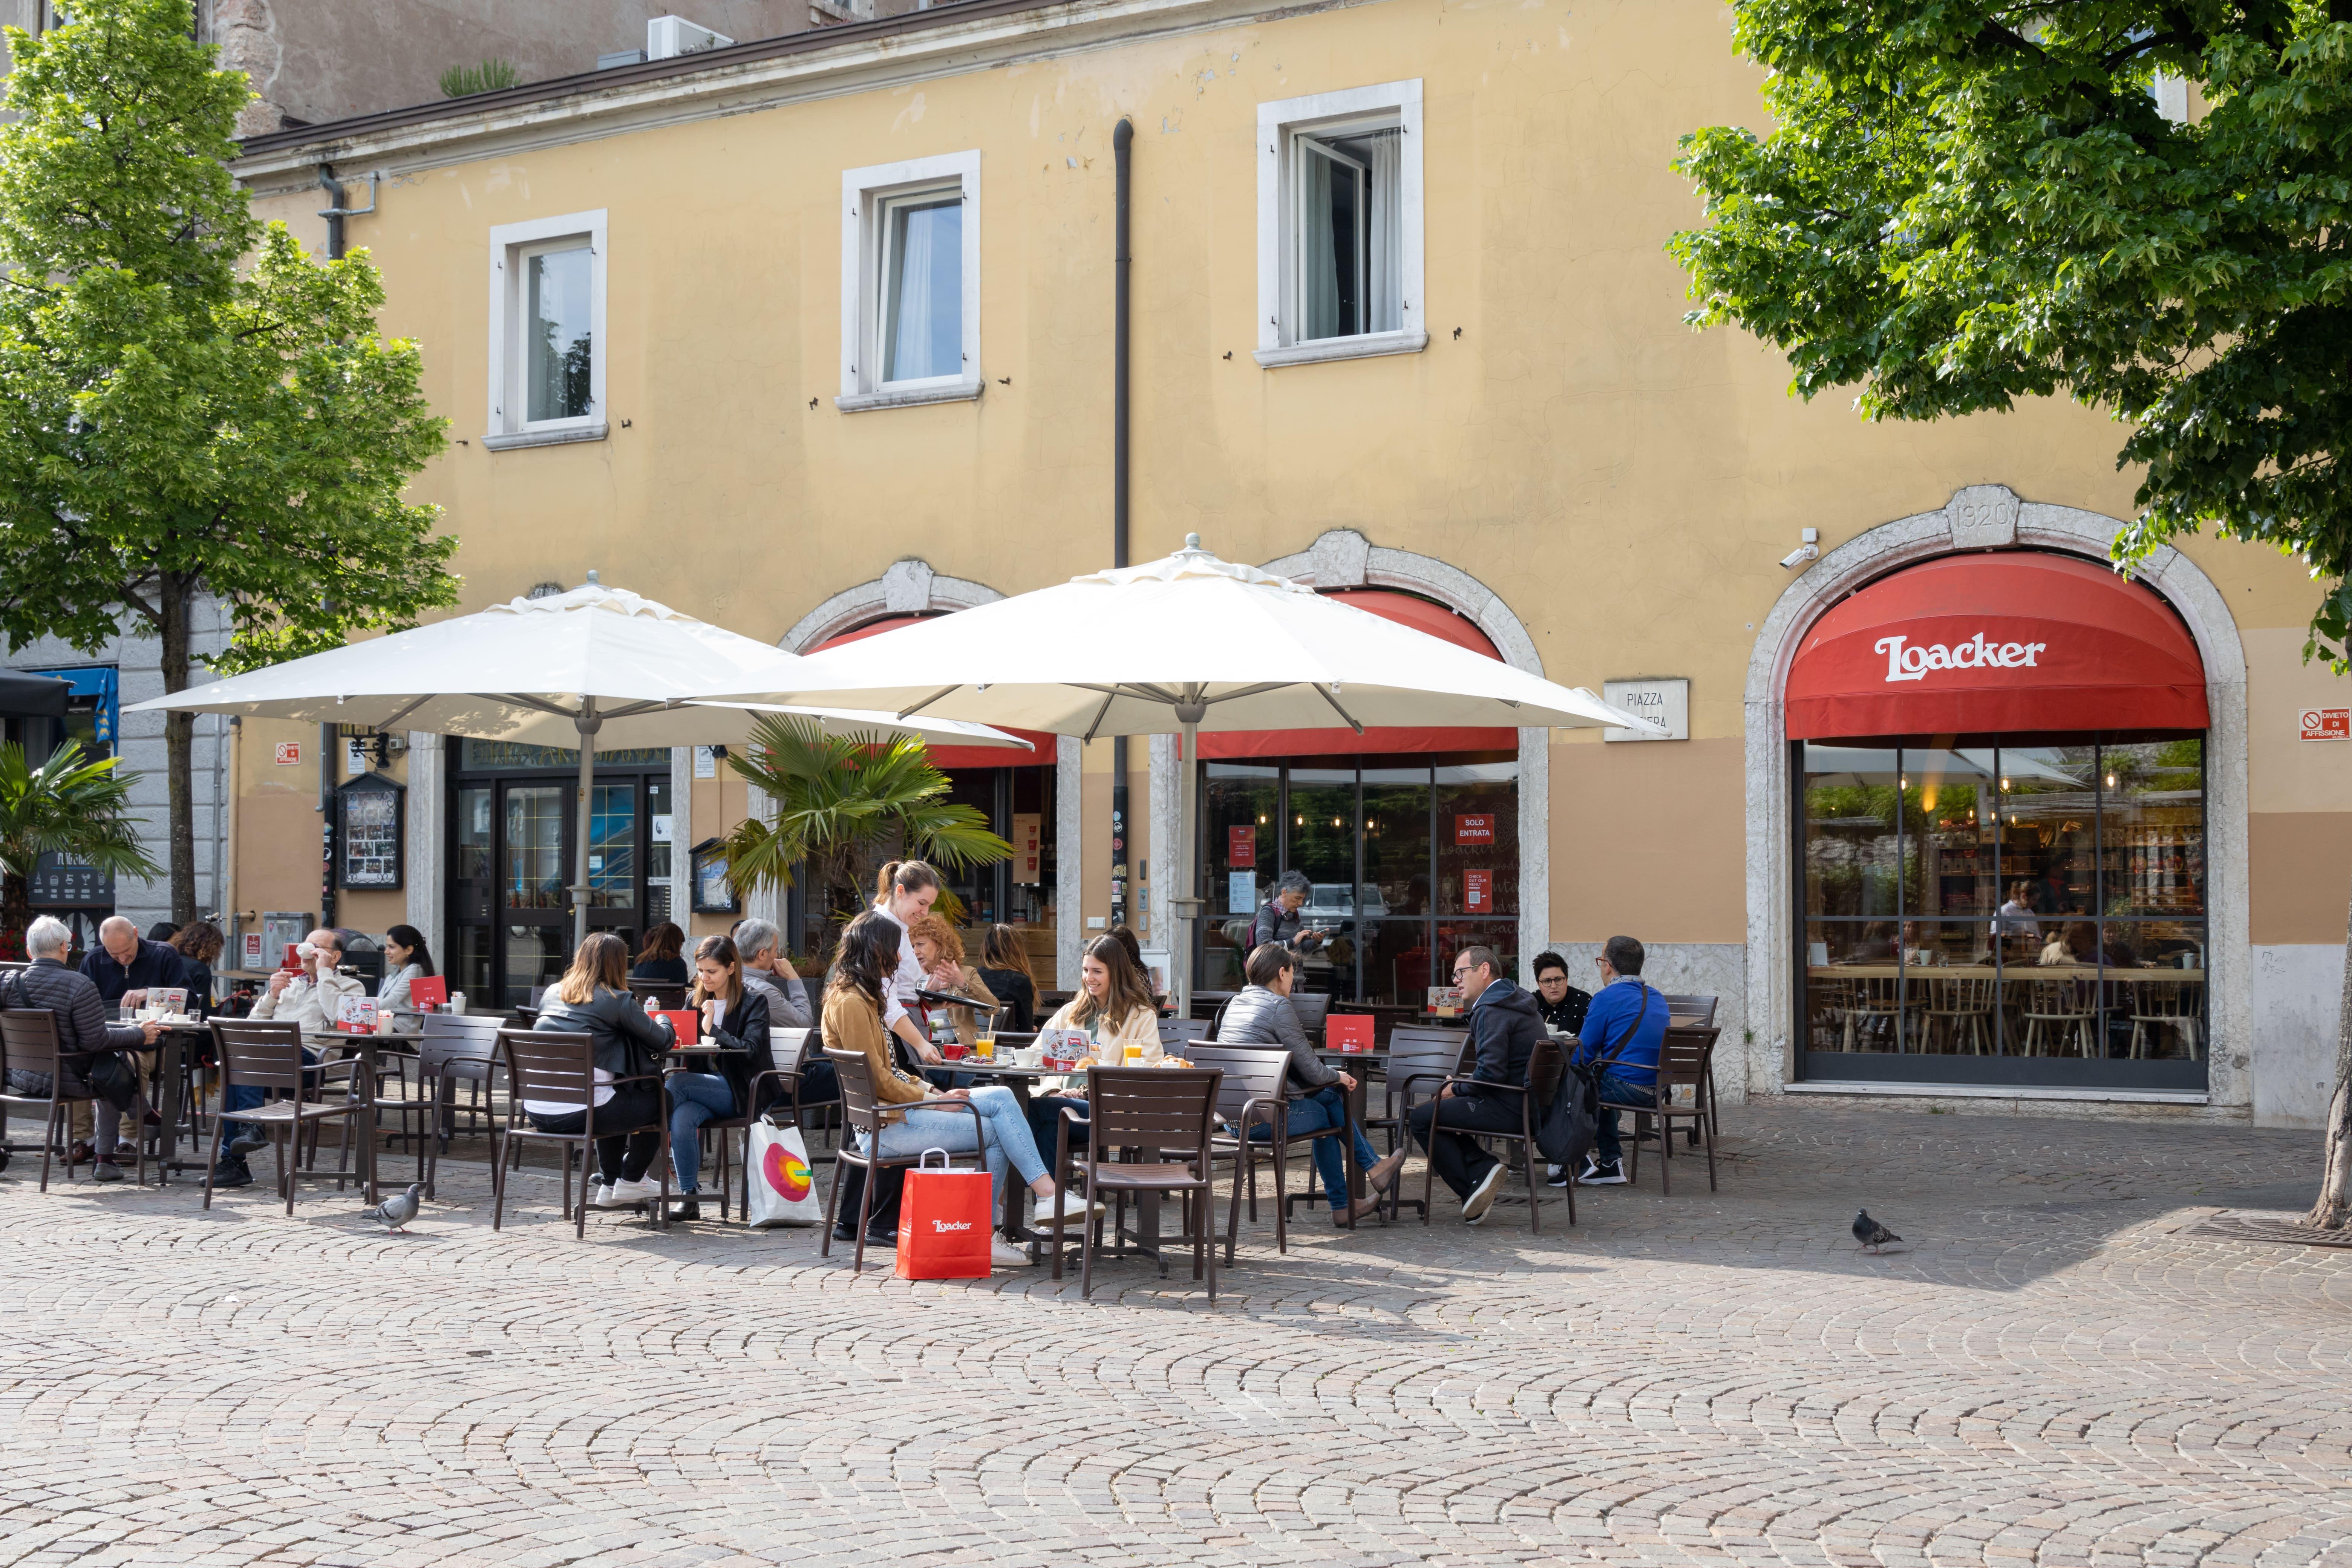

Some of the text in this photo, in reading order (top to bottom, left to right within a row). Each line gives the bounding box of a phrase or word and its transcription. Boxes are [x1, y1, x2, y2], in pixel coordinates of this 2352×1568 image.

[1957, 503, 2008, 528] 1920
[1874, 632, 2046, 682] Loacker
[1627, 692, 1663, 706] PIAZZA
[932, 1220, 972, 1232] Loacker
